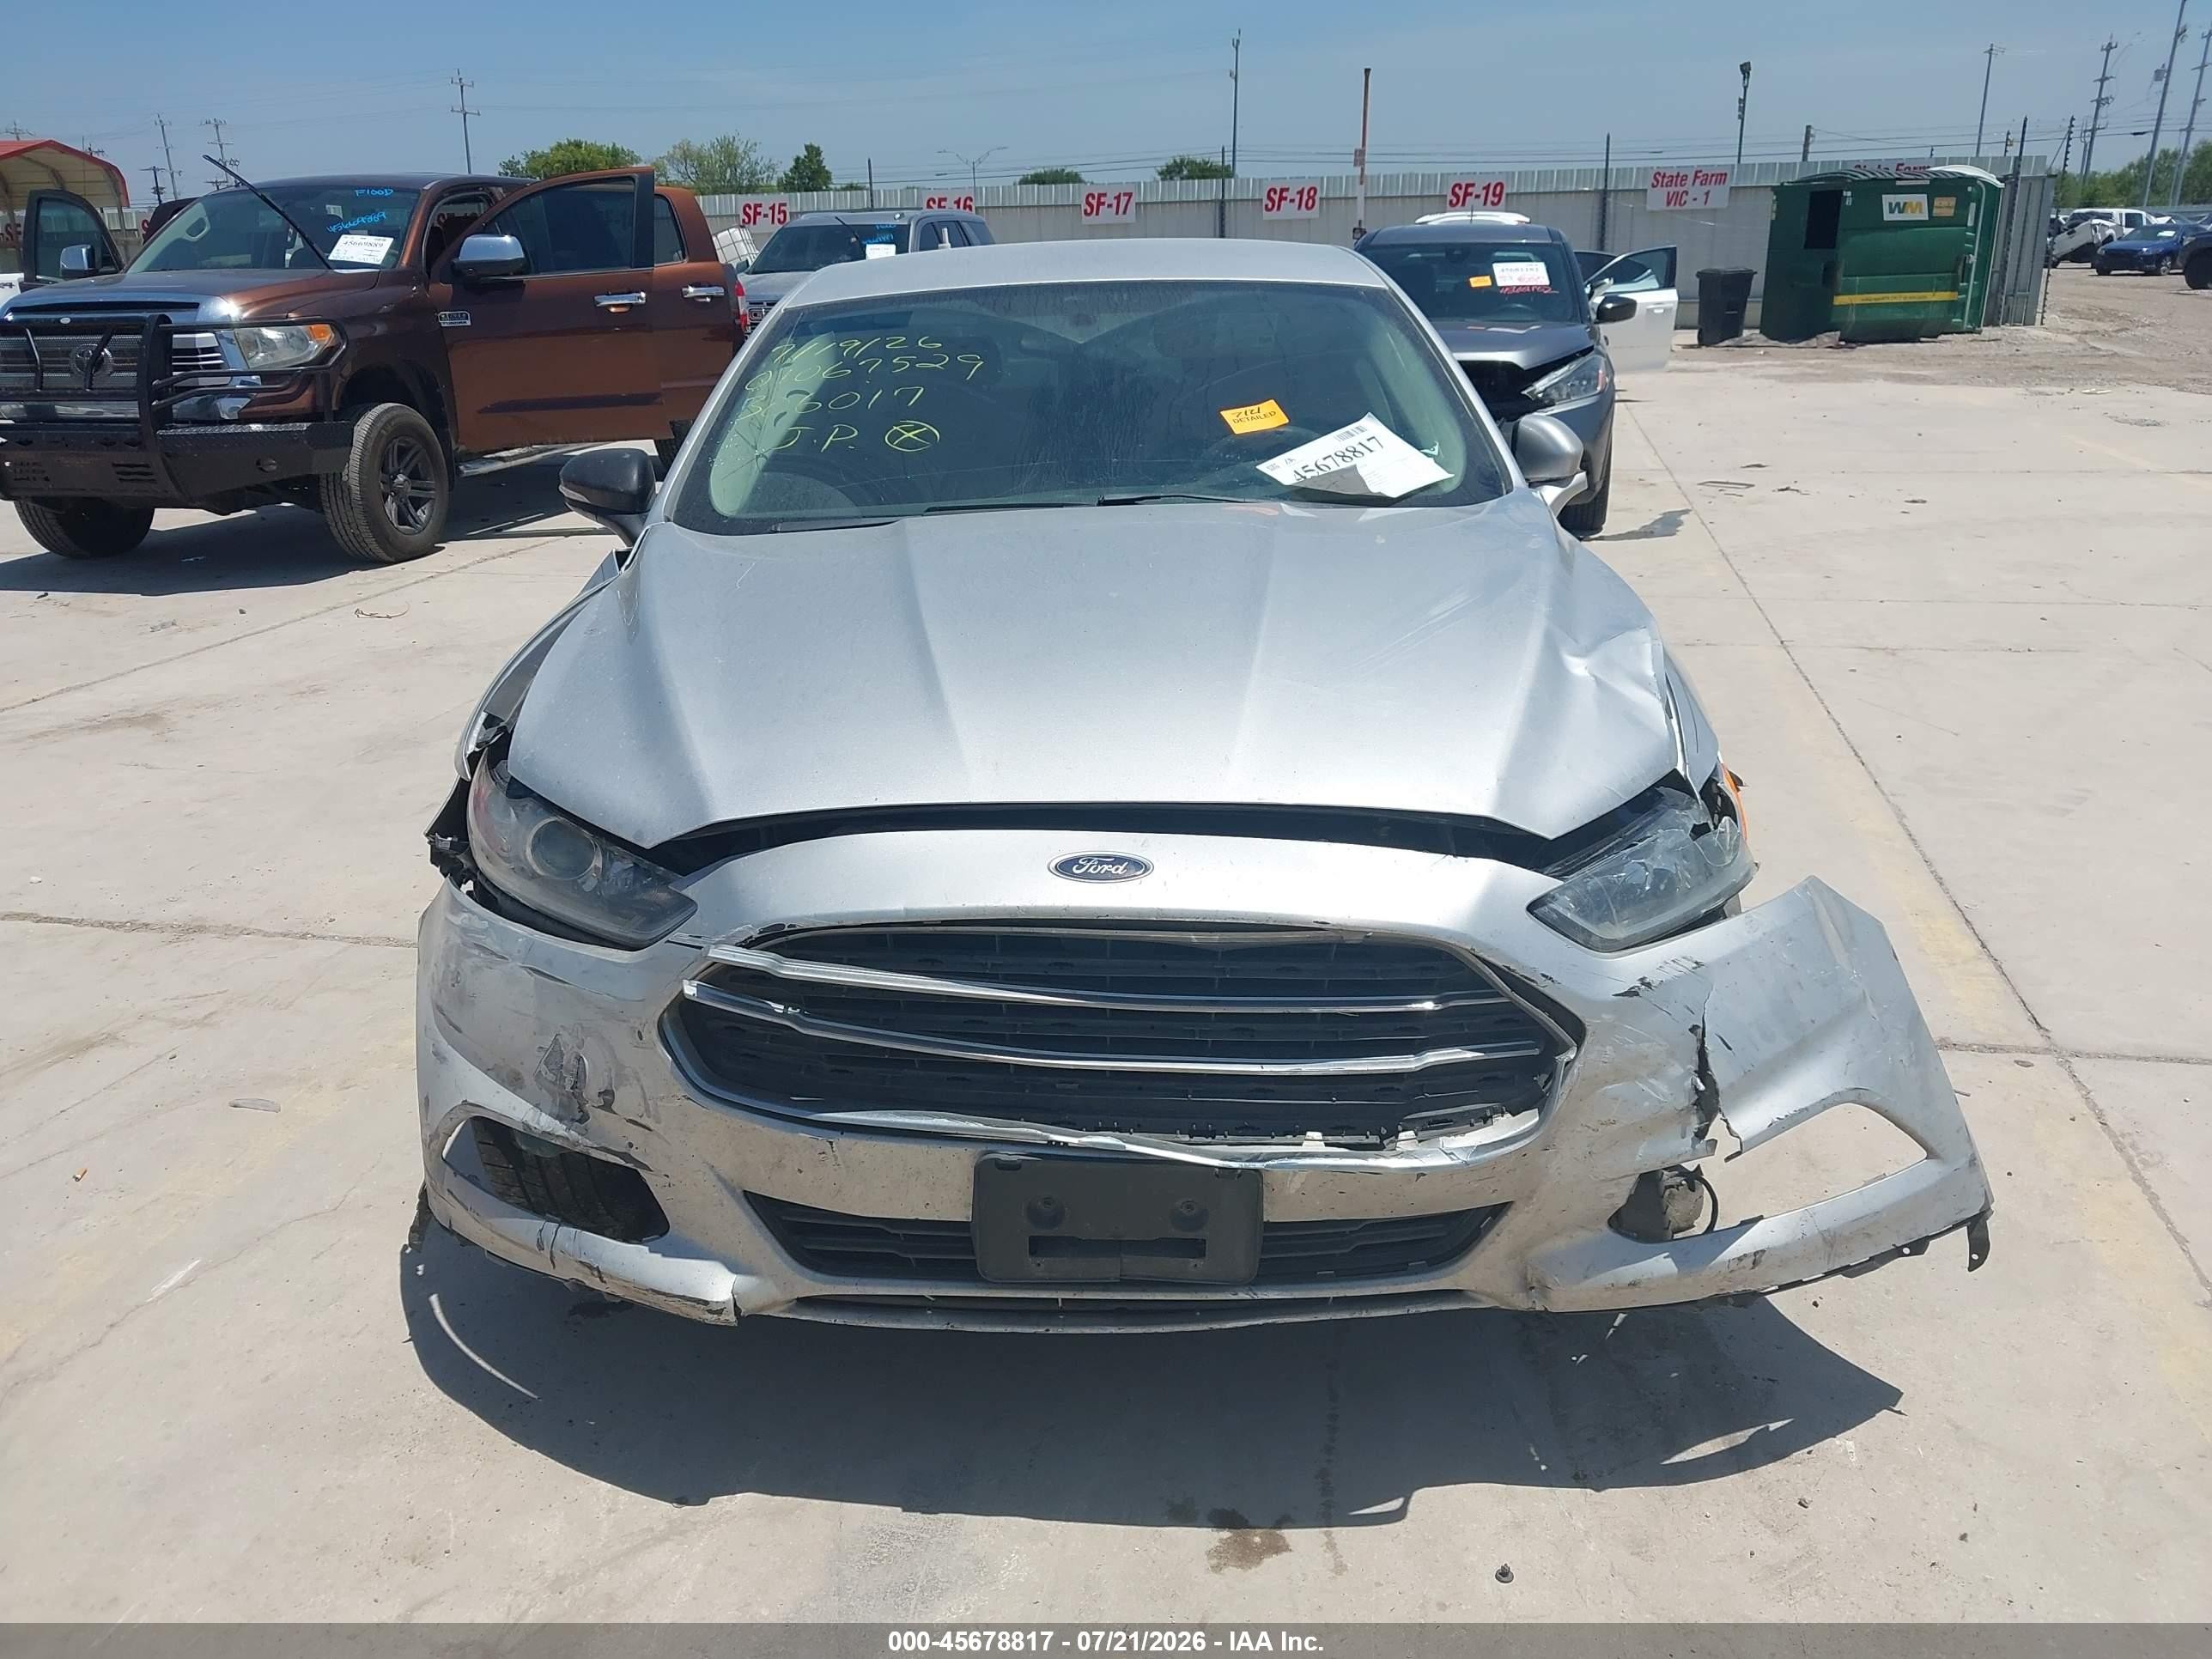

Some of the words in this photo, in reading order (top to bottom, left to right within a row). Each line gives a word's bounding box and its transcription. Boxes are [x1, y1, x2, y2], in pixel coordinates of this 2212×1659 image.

[1650, 171, 1688, 188] State
[1692, 169, 1729, 186] Farm
[1083, 191, 1134, 216] SF-17
[1264, 185, 1318, 213] SF-18
[1448, 181, 1506, 209] SF-19
[1666, 190, 1689, 207] VIC
[1704, 189, 1711, 207] 1
[742, 203, 787, 225] SF-15
[1888, 201, 1924, 215] WM
[1232, 410, 1277, 424] DETAILED
[1292, 435, 1385, 482] 45678817
[1072, 857, 1128, 874] Ford
